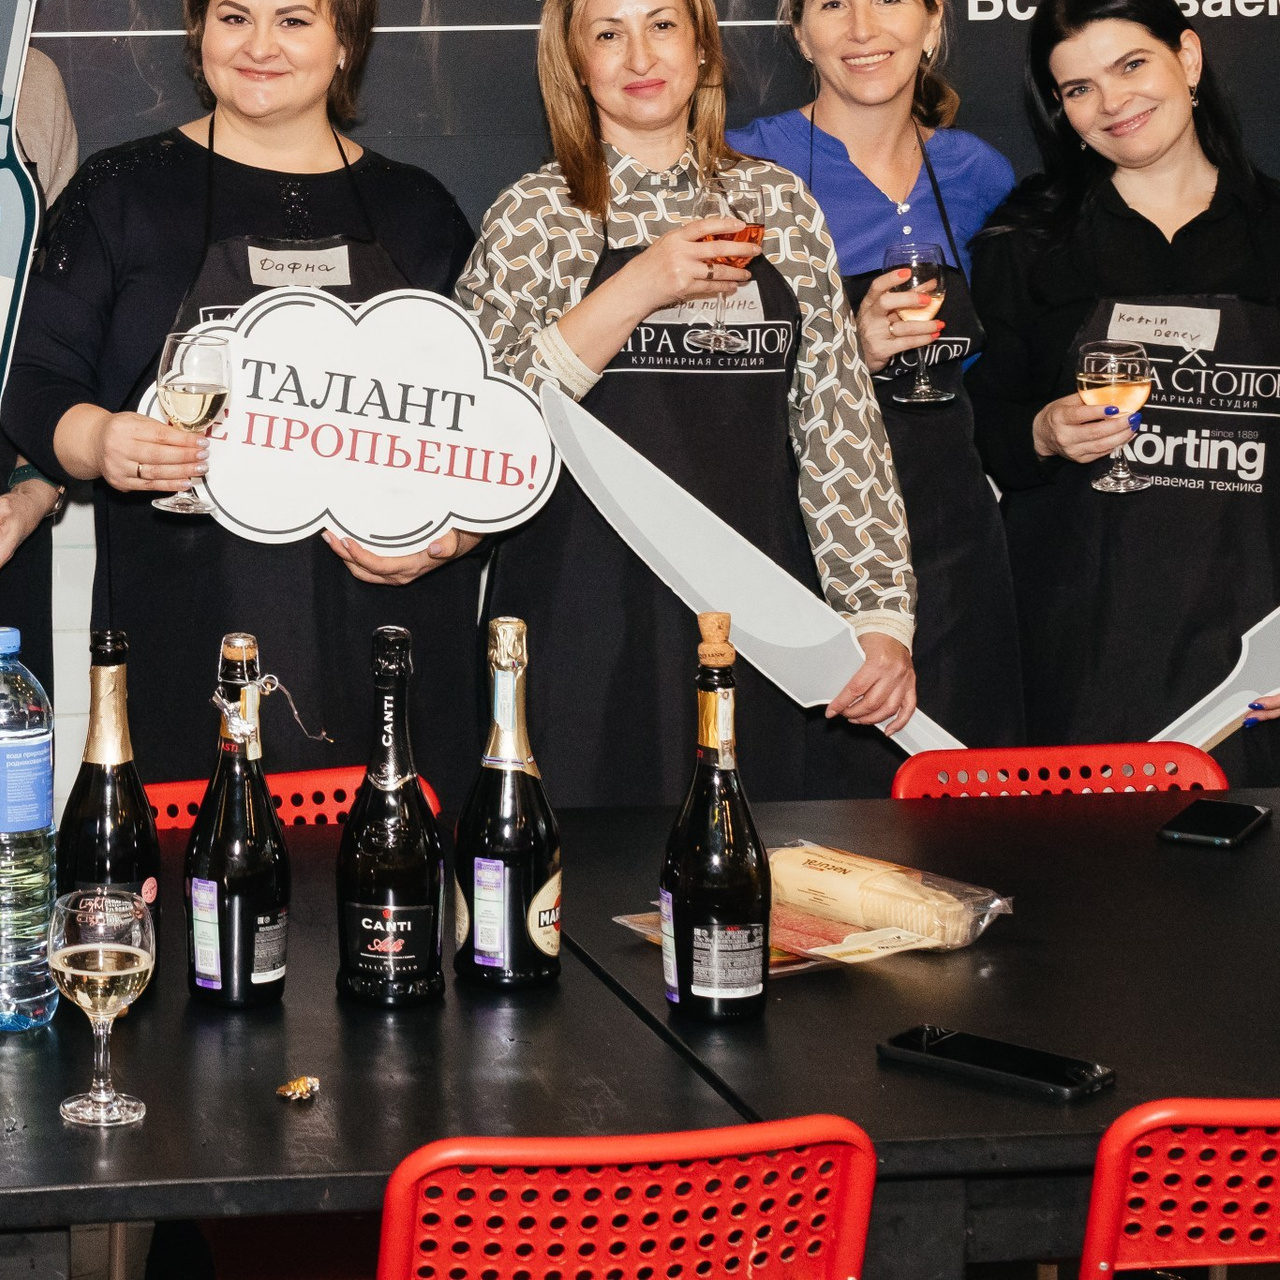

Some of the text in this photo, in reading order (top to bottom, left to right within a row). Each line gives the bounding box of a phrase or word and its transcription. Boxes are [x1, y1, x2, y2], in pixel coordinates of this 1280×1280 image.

[631, 355, 765, 367] КУЛИНАРНАЯ СТУДИЯ
[242, 358, 476, 433] ТАЛАНТ
[1151, 393, 1259, 409] НАРНАЯ СТУДИЯ
[1210, 428, 1259, 440] since 1889
[241, 411, 538, 491] ПРОПЬЕШЬ!
[1209, 479, 1263, 494] техника
[381, 695, 395, 747] CANTI
[361, 917, 412, 932] CANTI
